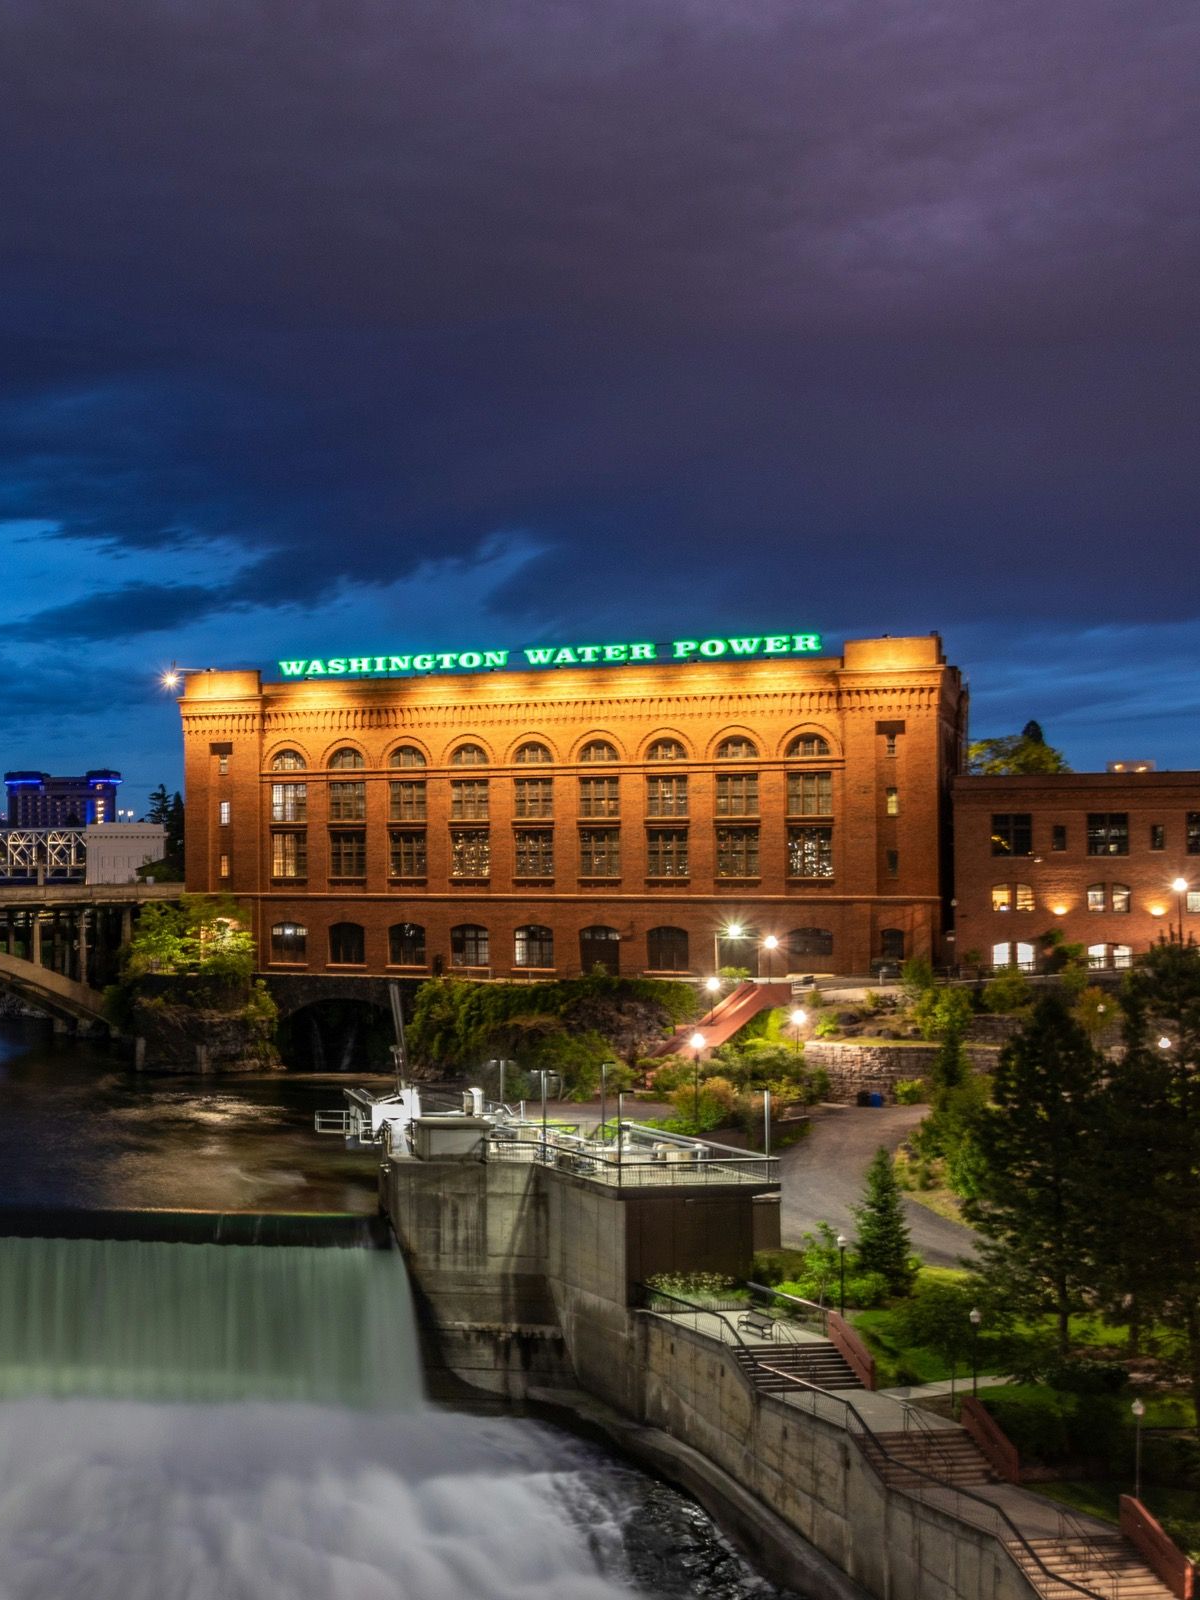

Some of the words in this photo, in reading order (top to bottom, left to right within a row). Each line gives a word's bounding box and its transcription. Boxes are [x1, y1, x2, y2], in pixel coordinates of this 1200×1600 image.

[279, 650, 509, 676] WASHINGTON
[523, 643, 657, 665] WATER
[673, 634, 822, 658] POWER
